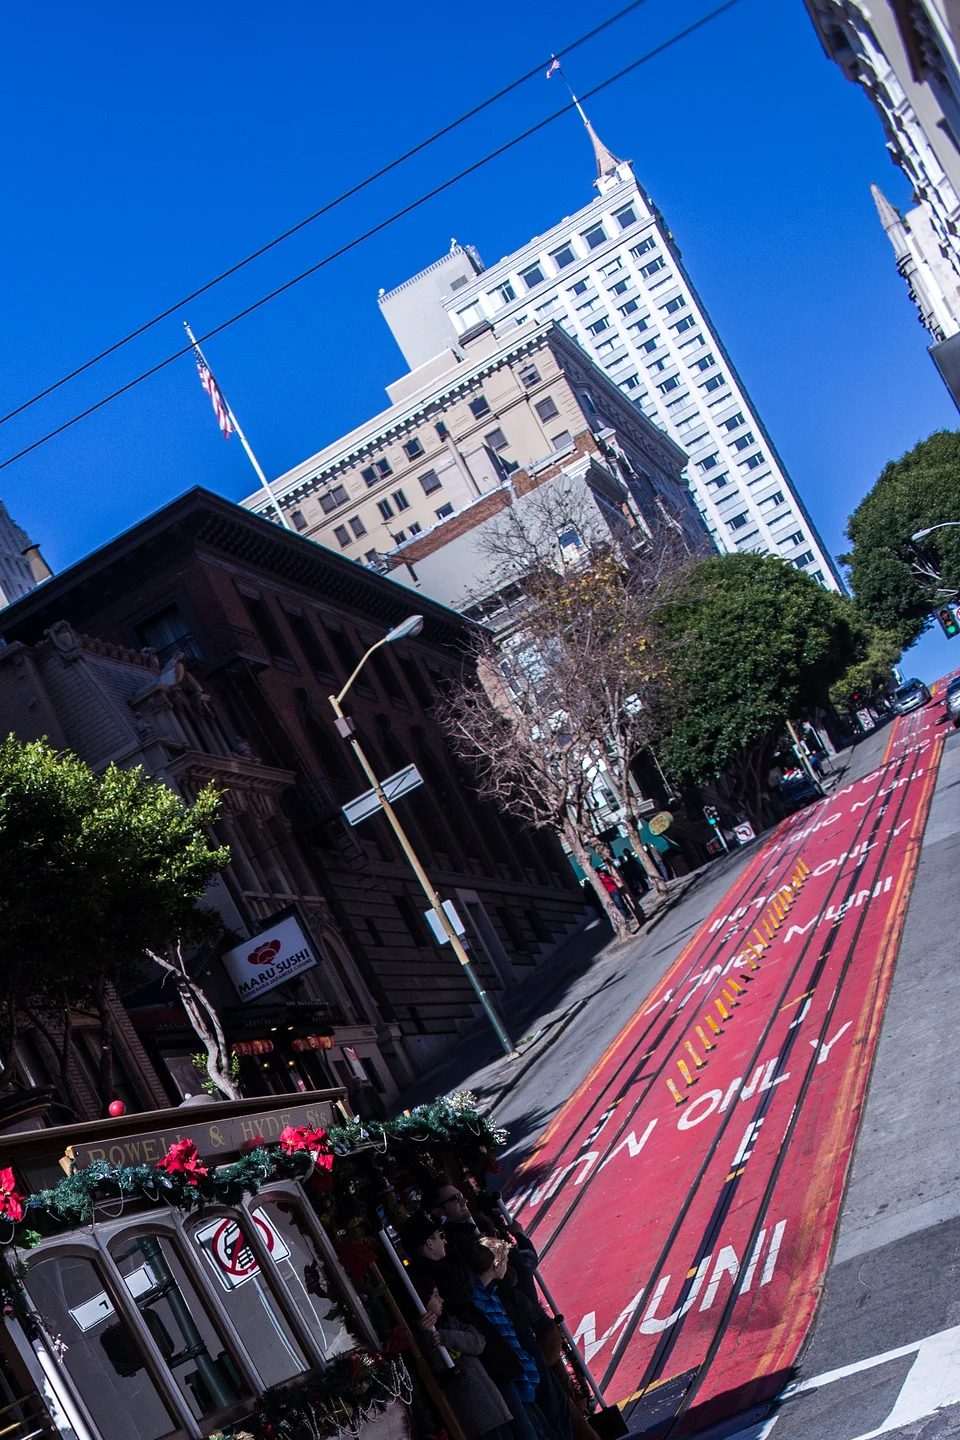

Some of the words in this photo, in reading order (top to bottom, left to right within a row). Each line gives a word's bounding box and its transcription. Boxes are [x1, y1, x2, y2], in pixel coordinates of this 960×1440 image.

[812, 818, 912, 877] ONLY
[783, 875, 893, 943] MUNI
[239, 967, 276, 995] MARU
[276, 948, 310, 974] SUSHI
[269, 970, 293, 985] JAPANESE
[677, 1021, 852, 1131] ONLY
[87, 1134, 183, 1166] POWELL
[209, 1126, 227, 1148] &
[240, 1113, 289, 1142] HYDE
[572, 1219, 788, 1365] MUNI
